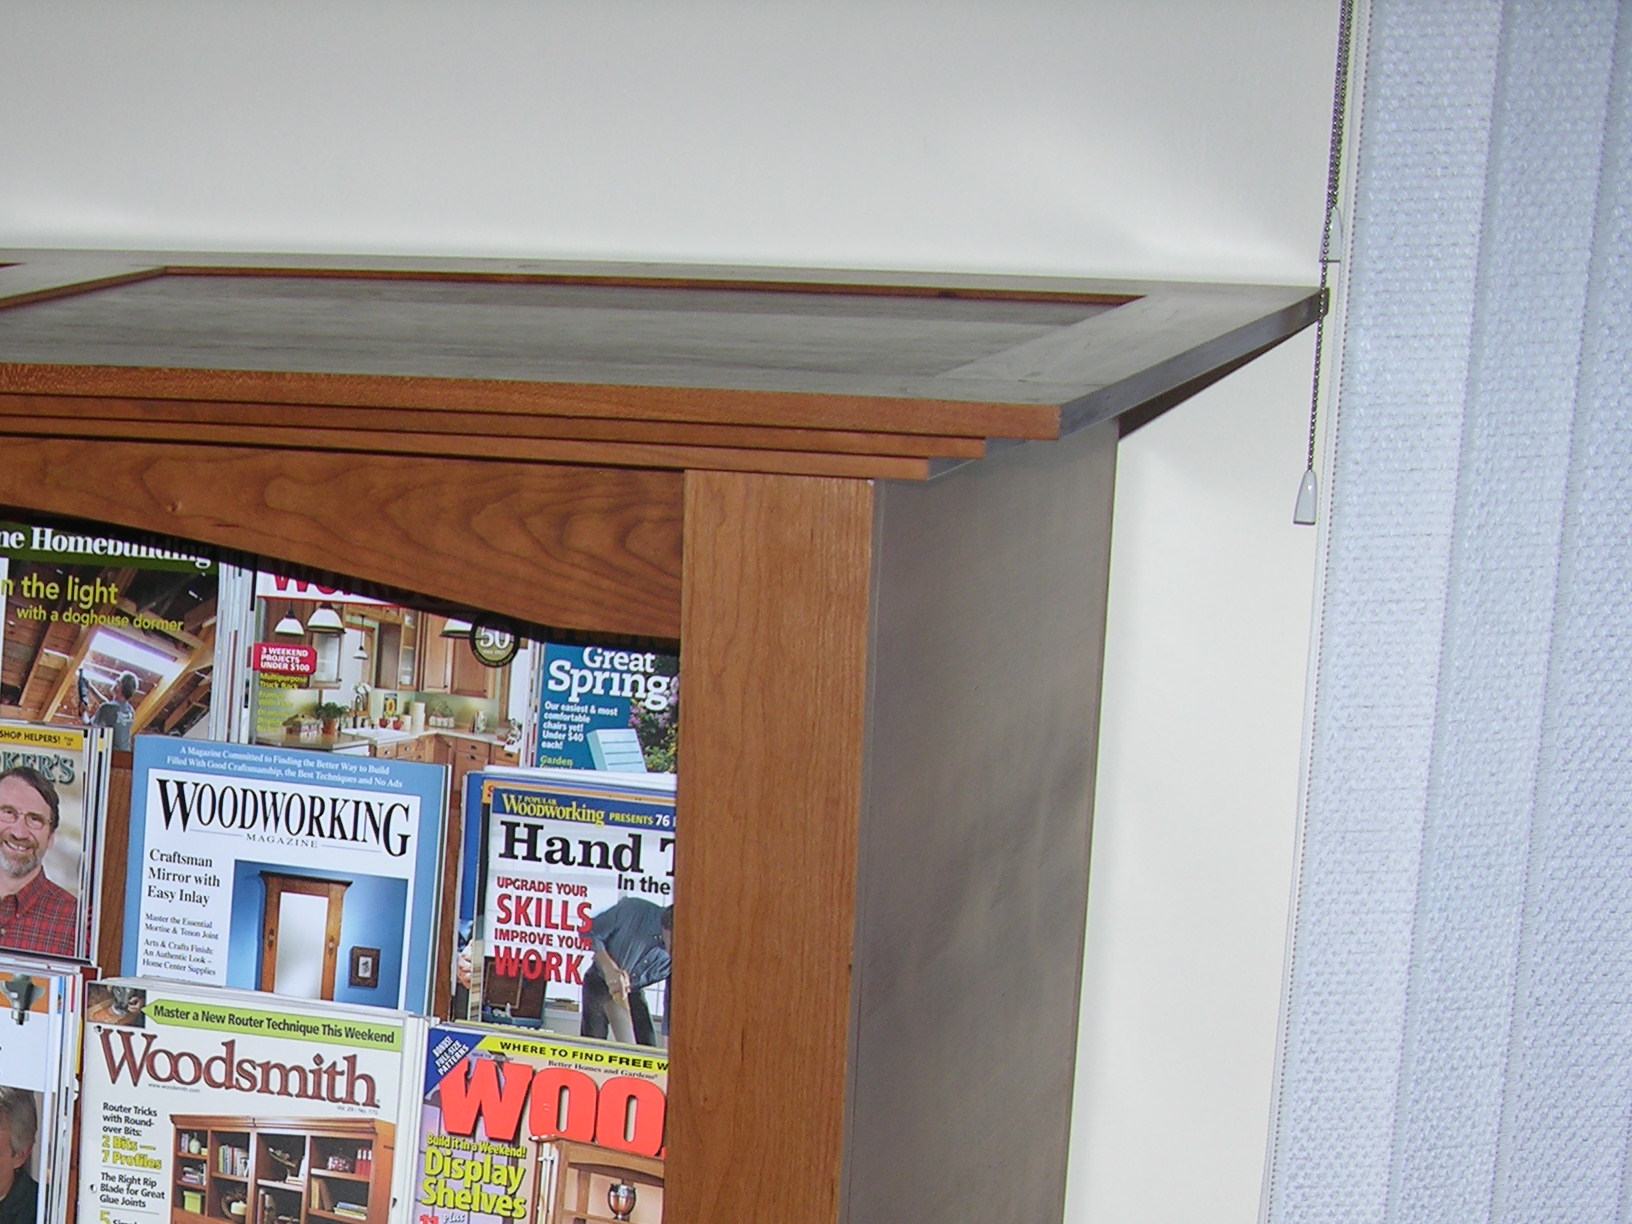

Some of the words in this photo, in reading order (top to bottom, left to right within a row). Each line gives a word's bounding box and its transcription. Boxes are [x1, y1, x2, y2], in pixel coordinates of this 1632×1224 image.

[21, 575, 60, 600] the
[67, 575, 119, 609] light
[17, 607, 47, 621] with
[50, 611, 59, 621] a
[62, 609, 129, 628] doghouse
[133, 614, 184, 632] dormer
[260, 661, 288, 671] UNDER
[290, 663, 310, 671] $100
[261, 654, 300, 664] PROJECTS
[268, 648, 308, 658] WEEKEND
[583, 646, 656, 673] Great
[547, 659, 670, 712] Spring
[545, 701, 559, 711] Our
[561, 703, 588, 714] easiest
[590, 706, 596, 714] &
[598, 706, 618, 716] most
[0, 730, 22, 740] SHOP
[24, 732, 61, 744] HELPERS!
[155, 777, 411, 857] WOODWORKING
[501, 794, 605, 827] Woodworking
[609, 813, 653, 825] PRESENTS
[655, 814, 670, 827] 76
[246, 832, 318, 849] MAGAZINE
[498, 820, 644, 876] Hand
[149, 849, 213, 869] Craftsman
[148, 867, 195, 886] Mirror
[197, 872, 221, 888] with
[496, 876, 553, 894] UPGRADE
[556, 882, 588, 897] YOUR
[147, 885, 177, 903] Easy
[179, 890, 210, 908] Inlay
[496, 893, 593, 935] SKILLS
[494, 928, 554, 946] IMPROVE
[557, 935, 593, 951] YOUR
[142, 958, 163, 968] Home
[165, 960, 187, 971] Center
[188, 964, 216, 976] Supplies
[494, 945, 585, 986] WORK
[153, 1005, 191, 1021] Master
[192, 1012, 199, 1022] a
[201, 1010, 226, 1024] New
[228, 1013, 264, 1029] Router
[266, 1017, 320, 1036] Technique
[321, 1023, 343, 1037] This
[344, 1026, 395, 1044] Weekend
[93, 1025, 381, 1108] Woodsmith
[500, 1041, 547, 1056] WHERE
[550, 1047, 568, 1058] TO
[572, 1049, 605, 1063] FIND
[607, 1054, 653, 1070] FREE
[102, 1102, 132, 1116] Router
[133, 1106, 158, 1117] Tricks
[439, 1058, 666, 1160] WOO
[425, 1147, 527, 1195] Display
[421, 1178, 527, 1219] Shelves
